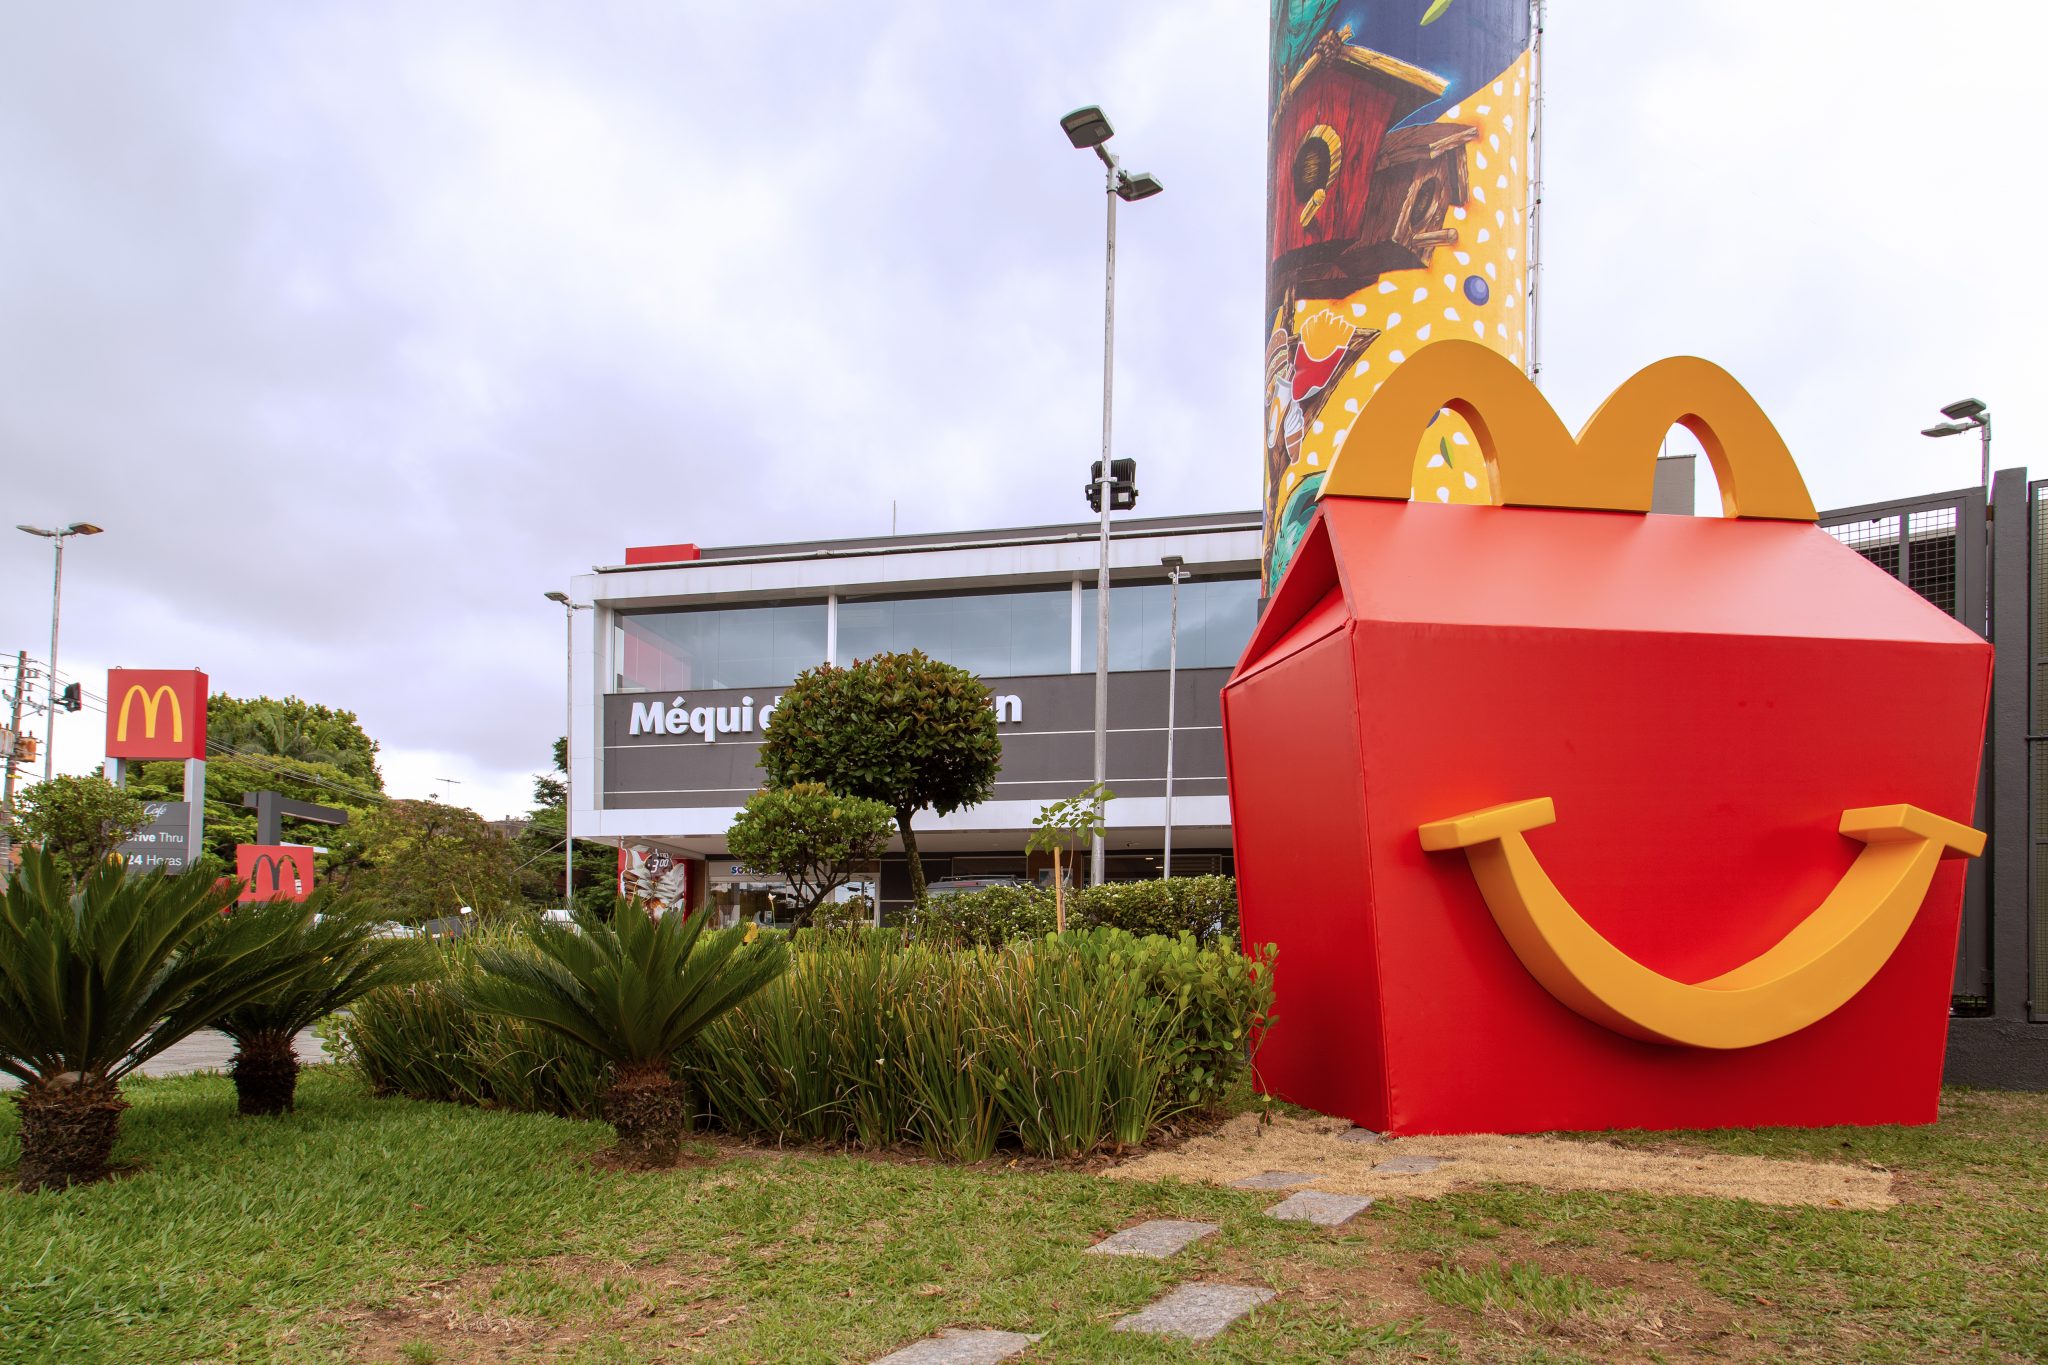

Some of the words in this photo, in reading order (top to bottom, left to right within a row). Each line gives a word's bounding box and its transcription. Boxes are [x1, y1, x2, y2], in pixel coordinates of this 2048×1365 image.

[629, 696, 754, 743] Méqui
[143, 803, 168, 818] Café
[159, 832, 184, 843] Thru
